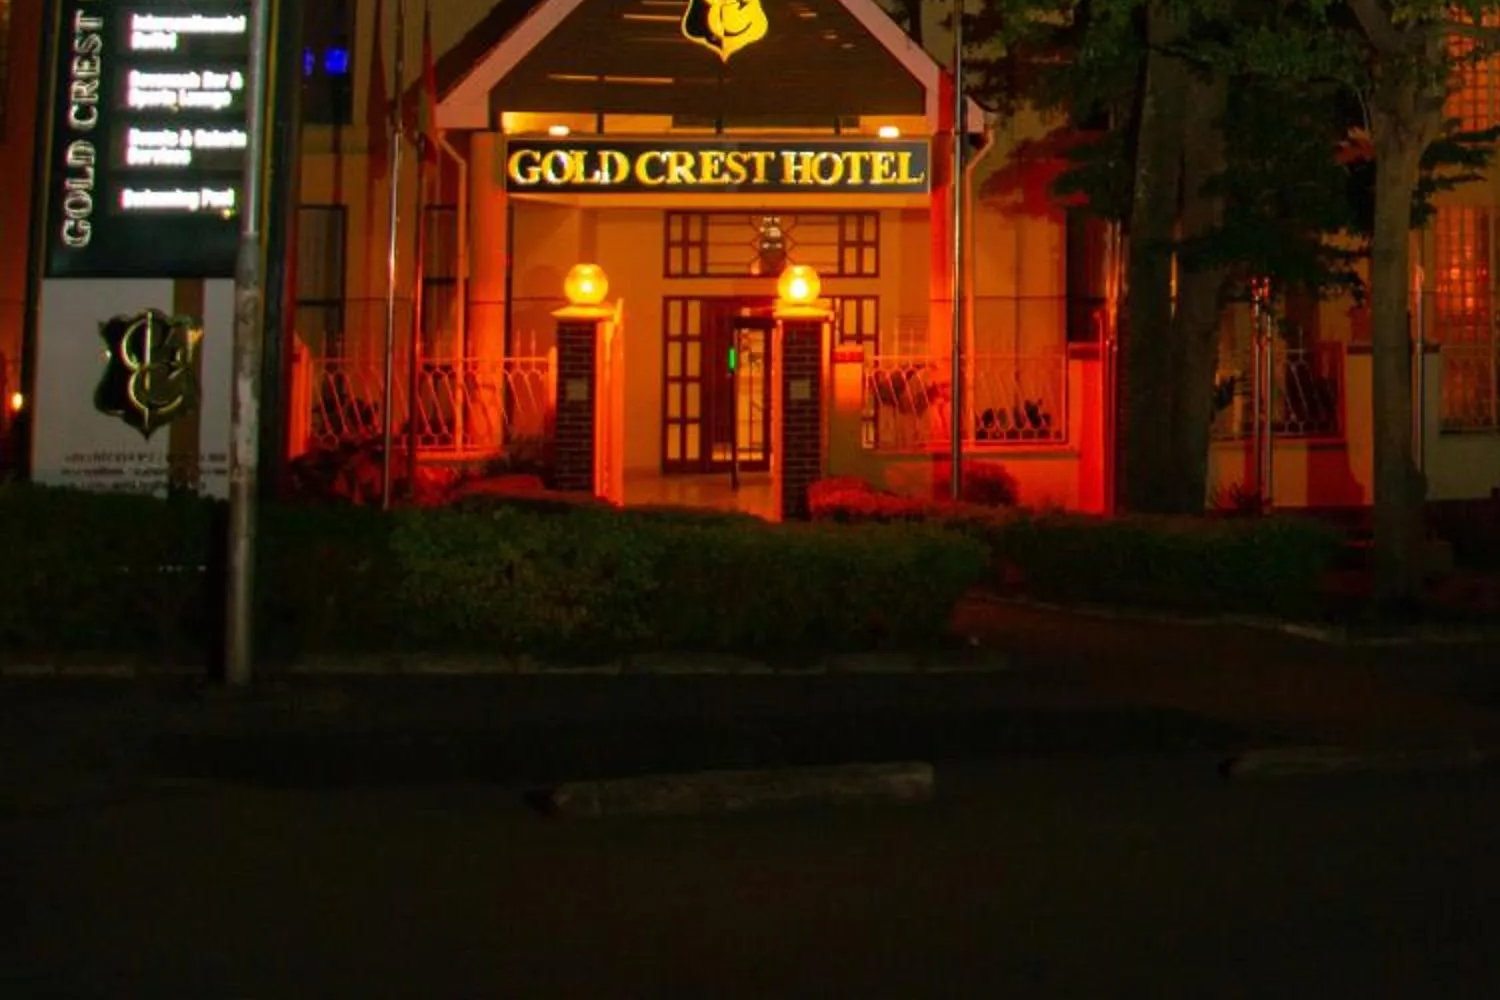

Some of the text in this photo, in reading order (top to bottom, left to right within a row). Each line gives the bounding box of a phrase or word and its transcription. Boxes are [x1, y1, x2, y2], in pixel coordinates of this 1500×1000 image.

[69, 9, 104, 131] CREST
[61, 140, 95, 248] GOLD
[507, 149, 926, 187] GOLD CREST HOTEL
